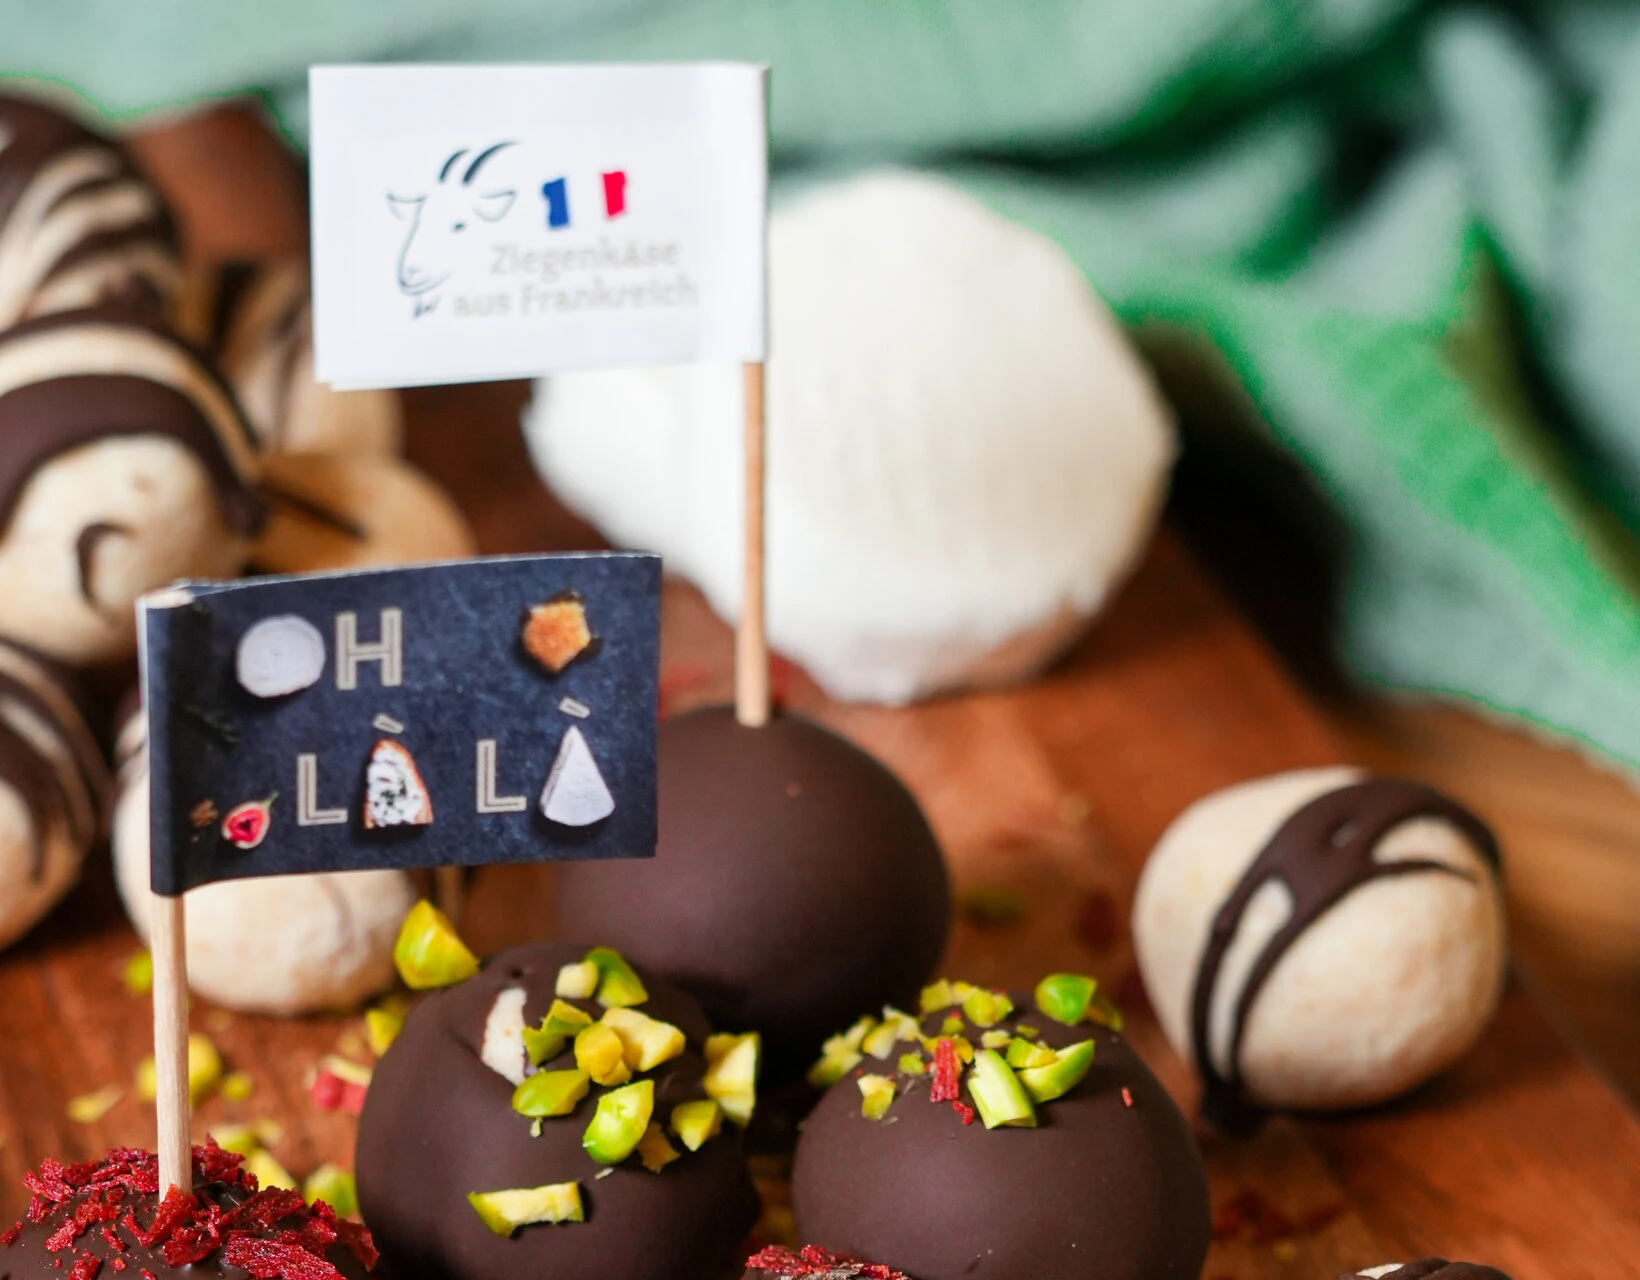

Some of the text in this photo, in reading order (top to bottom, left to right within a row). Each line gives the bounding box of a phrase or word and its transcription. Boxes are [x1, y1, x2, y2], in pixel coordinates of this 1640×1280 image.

[490, 237, 681, 282] Ziegenkäse
[453, 272, 699, 317] aus Frankreich
